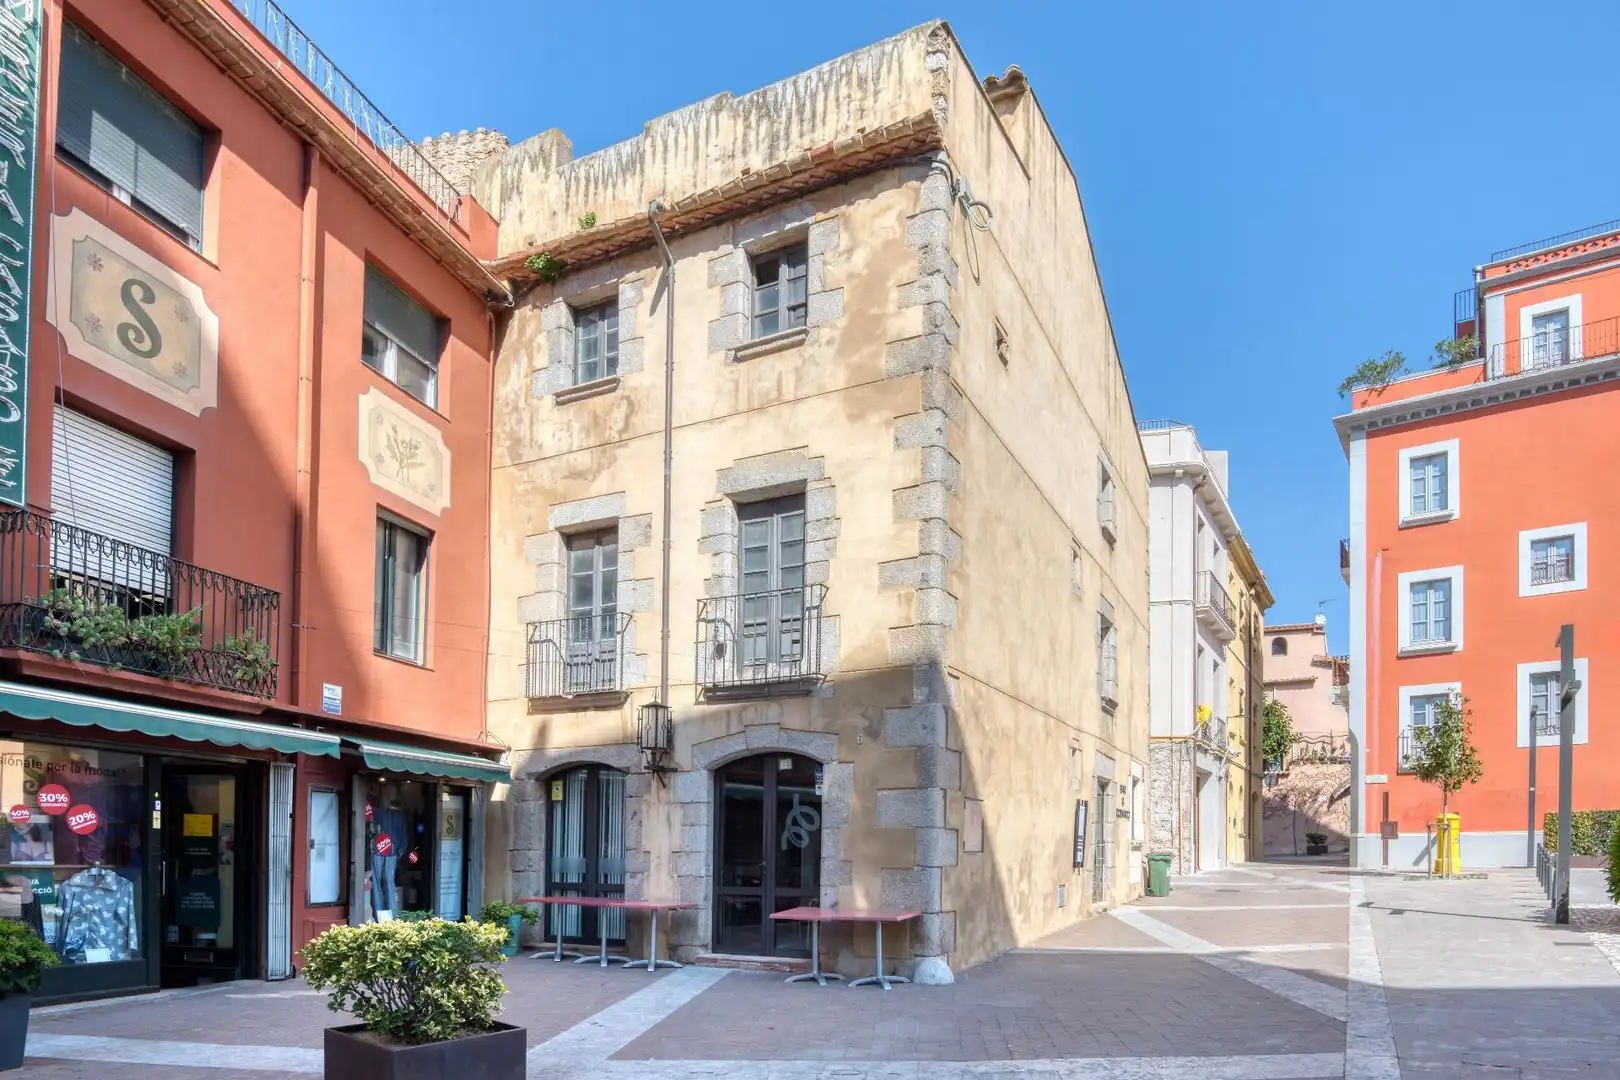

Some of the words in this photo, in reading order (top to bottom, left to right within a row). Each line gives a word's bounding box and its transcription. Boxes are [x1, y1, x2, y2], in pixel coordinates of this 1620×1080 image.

[856, 733, 863, 745] 6
[47, 762, 67, 773] por
[70, 761, 81, 774] la
